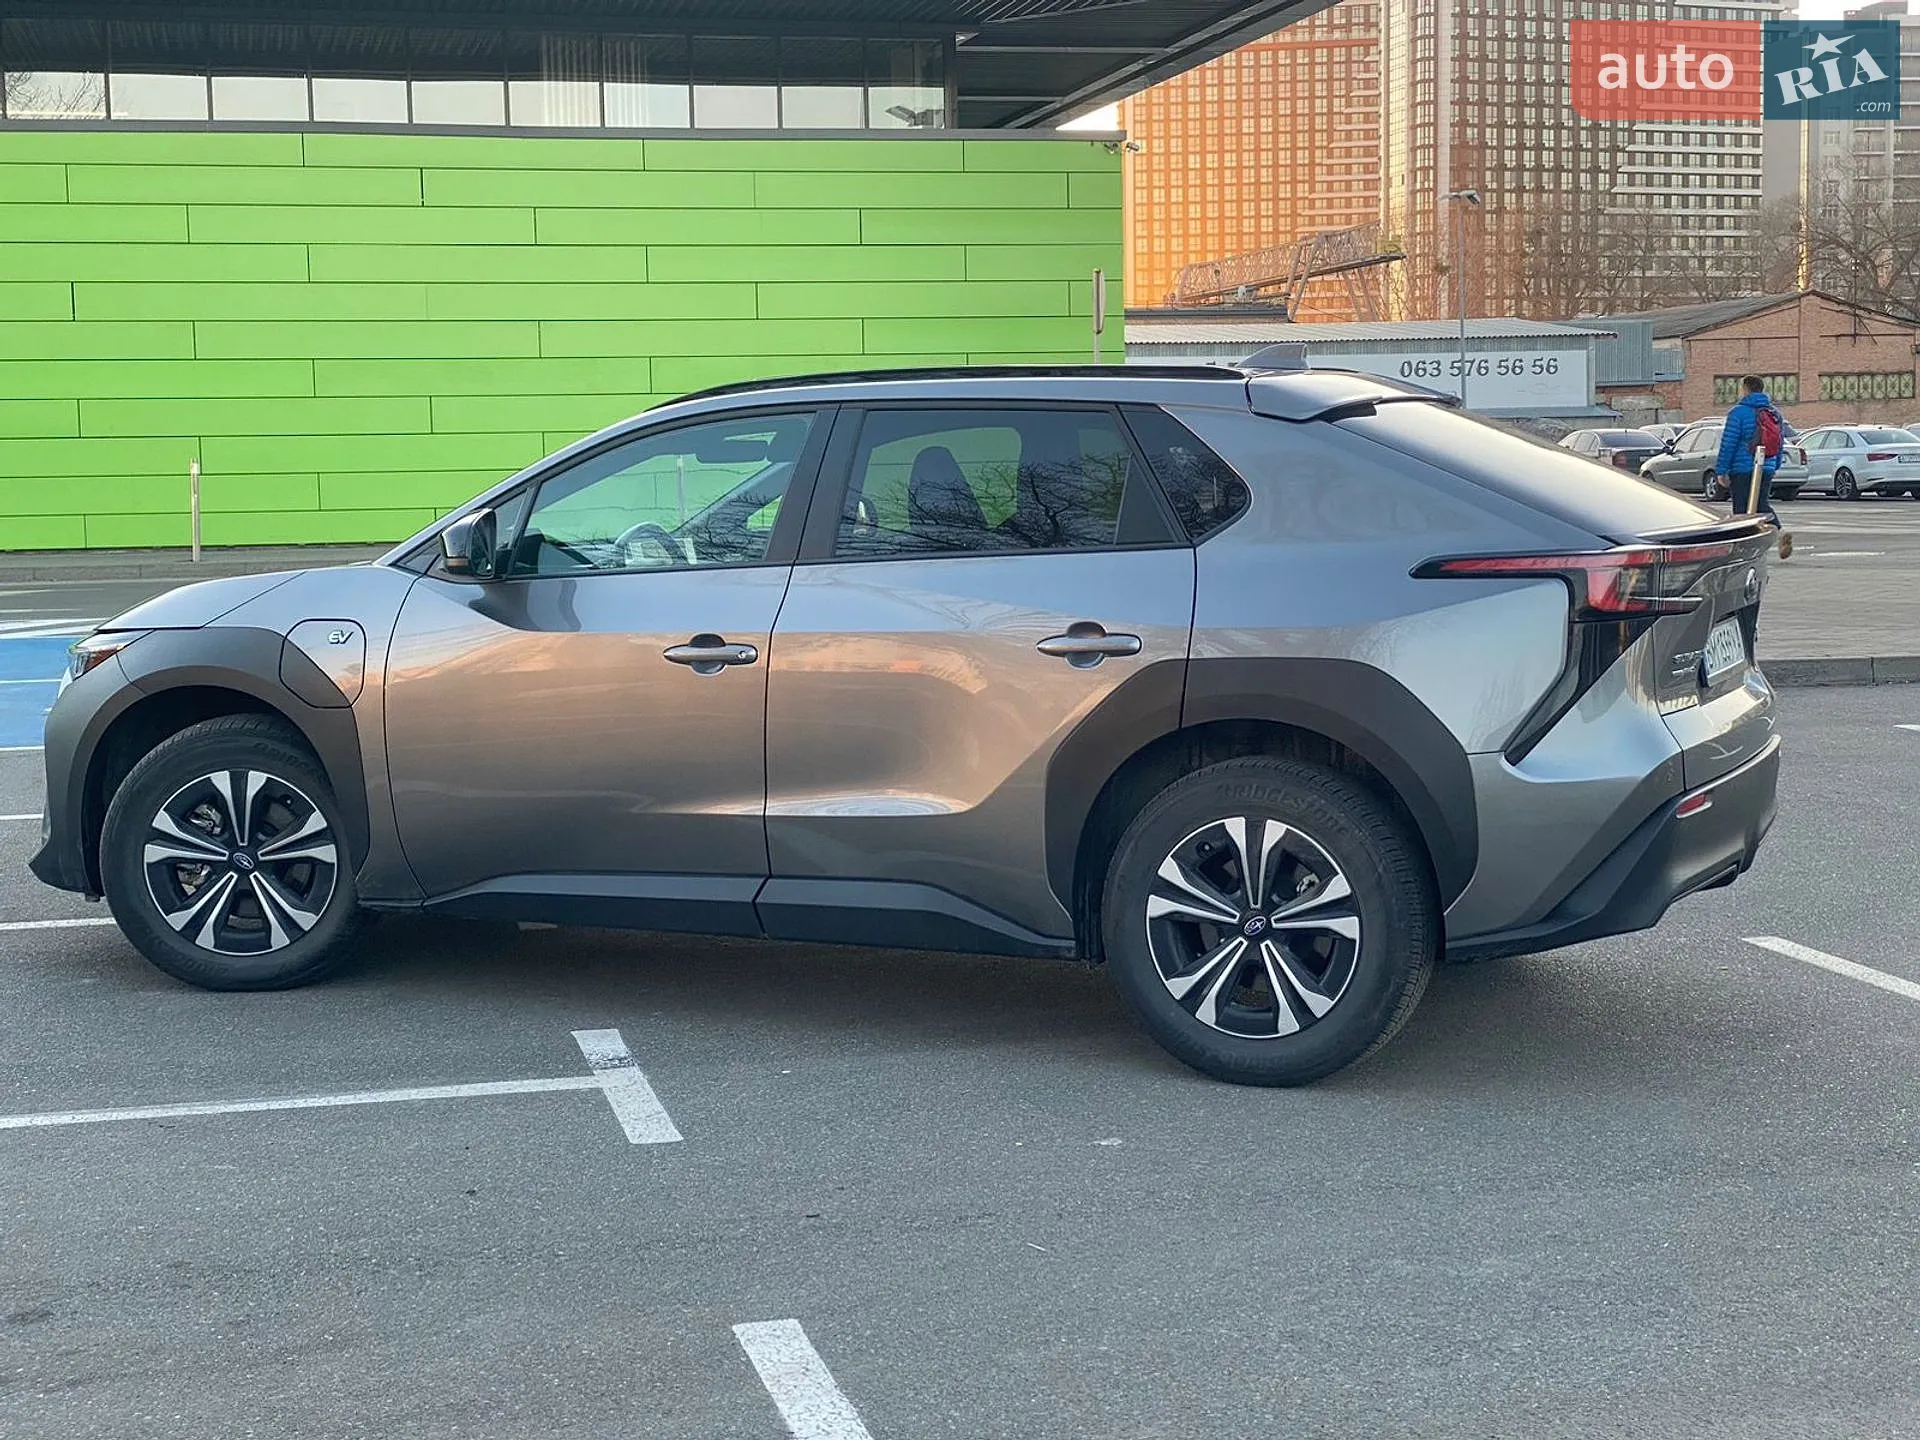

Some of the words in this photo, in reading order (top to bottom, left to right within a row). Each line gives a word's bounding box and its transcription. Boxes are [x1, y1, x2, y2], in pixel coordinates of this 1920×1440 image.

[1400, 360, 1442, 378] 063
[1449, 358, 1490, 377] 576
[1497, 357, 1524, 376] 56
[1531, 356, 1559, 375] 56
[328, 630, 354, 645] EV
